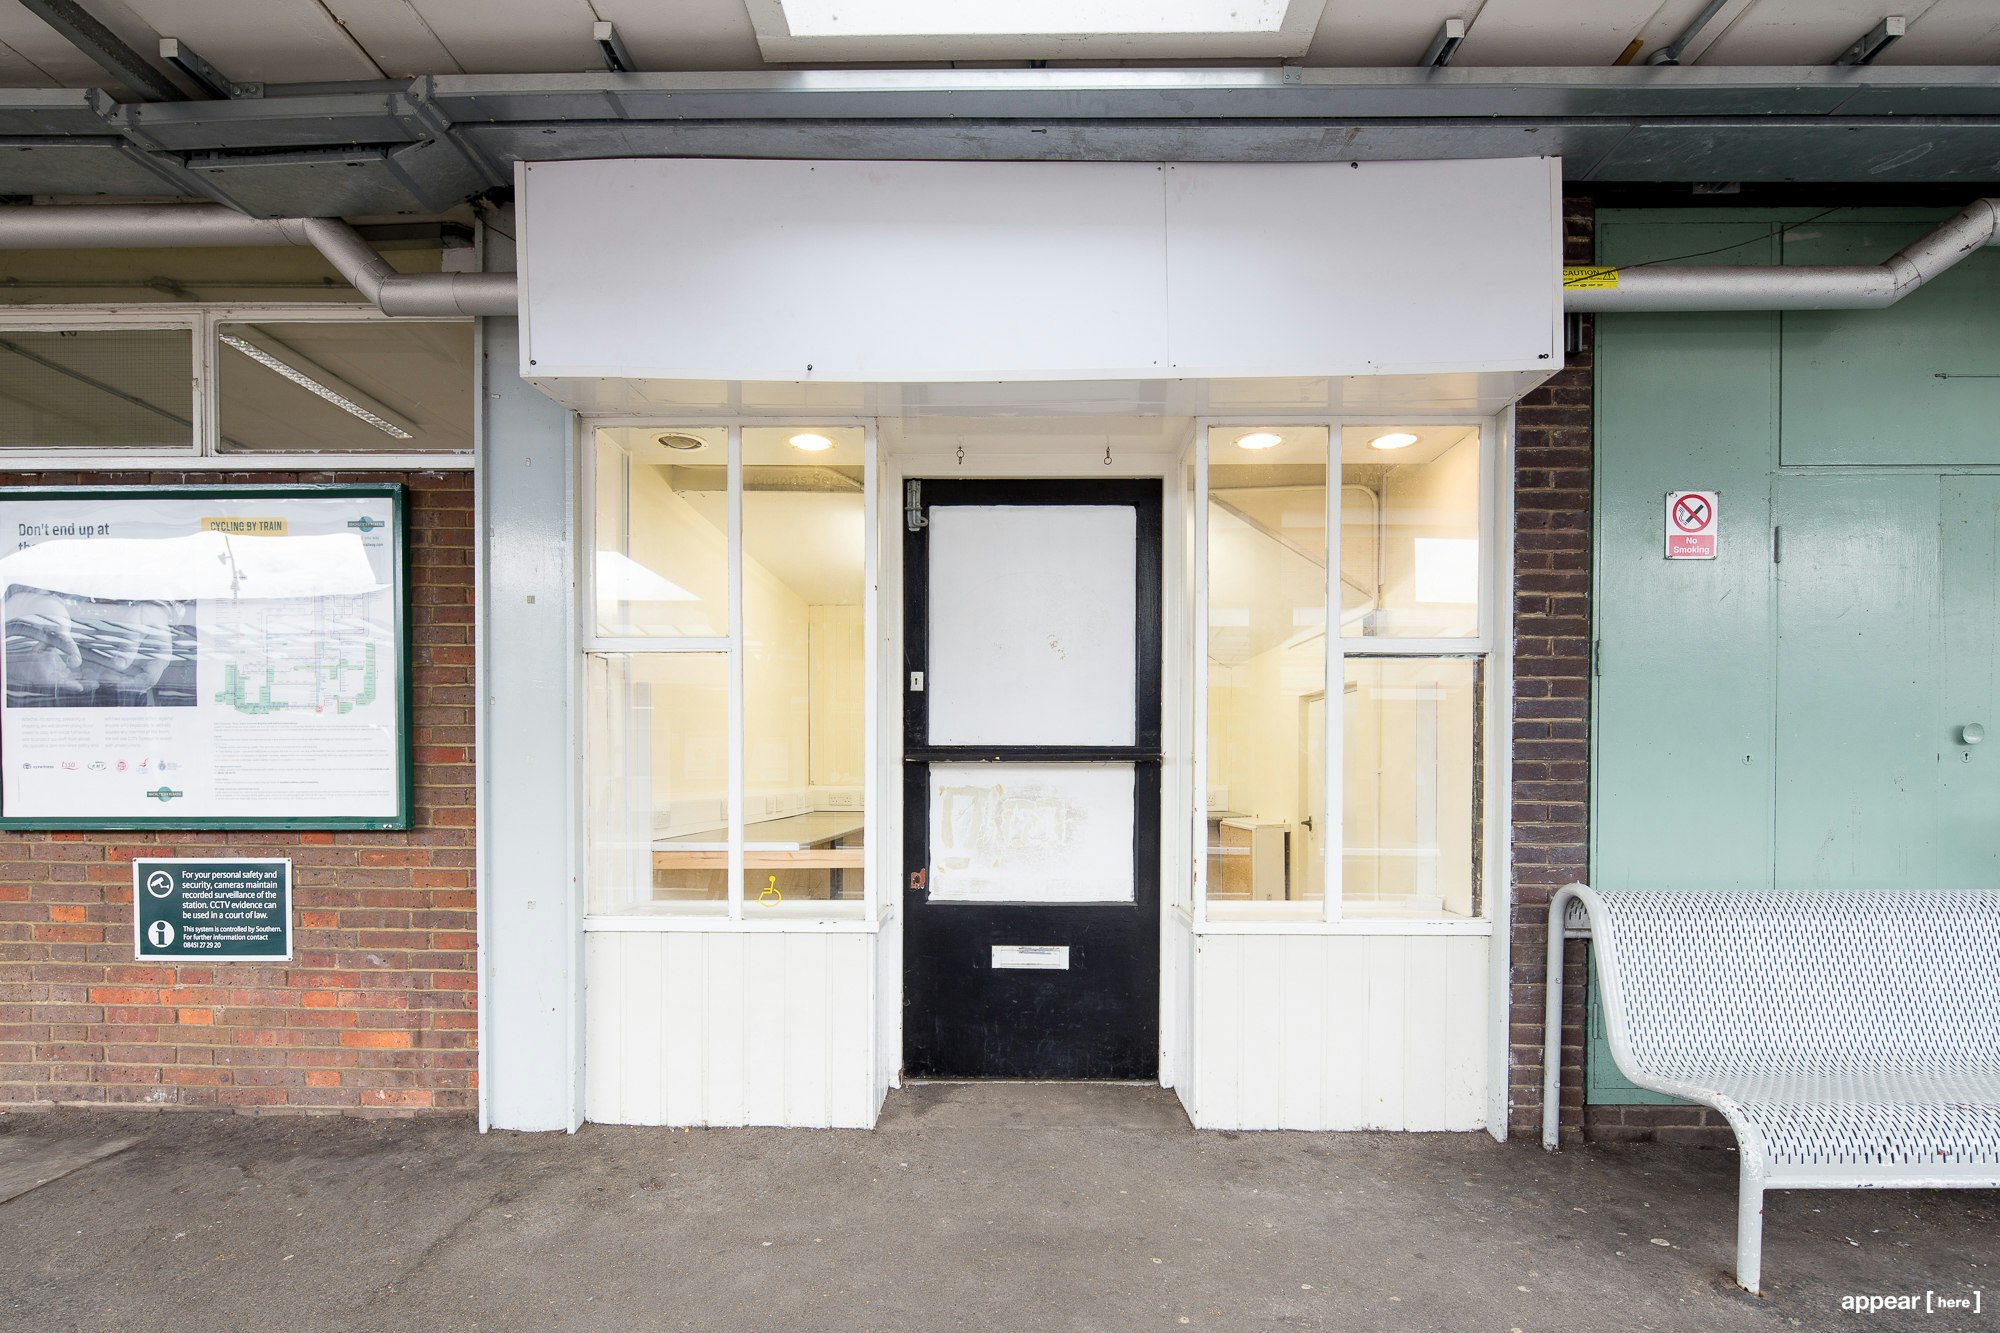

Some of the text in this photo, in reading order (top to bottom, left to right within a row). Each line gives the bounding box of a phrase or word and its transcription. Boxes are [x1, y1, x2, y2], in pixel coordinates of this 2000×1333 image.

[18, 523, 110, 538] Don't end up at
[210, 521, 282, 532] CYCLING BY TRAIN
[1674, 546, 1710, 555] Smoking
[182, 870, 277, 880] For your personal safety and
[182, 880, 213, 891] security,
[245, 880, 278, 889] maintain
[182, 890, 277, 899] recorded surveillance of the
[182, 900, 208, 909] station.
[209, 900, 231, 909] CCTV
[231, 900, 262, 909] evidence
[182, 910, 192, 919] be
[193, 910, 209, 919] used
[211, 911, 218, 919] in
[225, 911, 244, 919] court
[245, 910, 254, 919] of
[254, 910, 268, 919] law.
[183, 925, 195, 933] This
